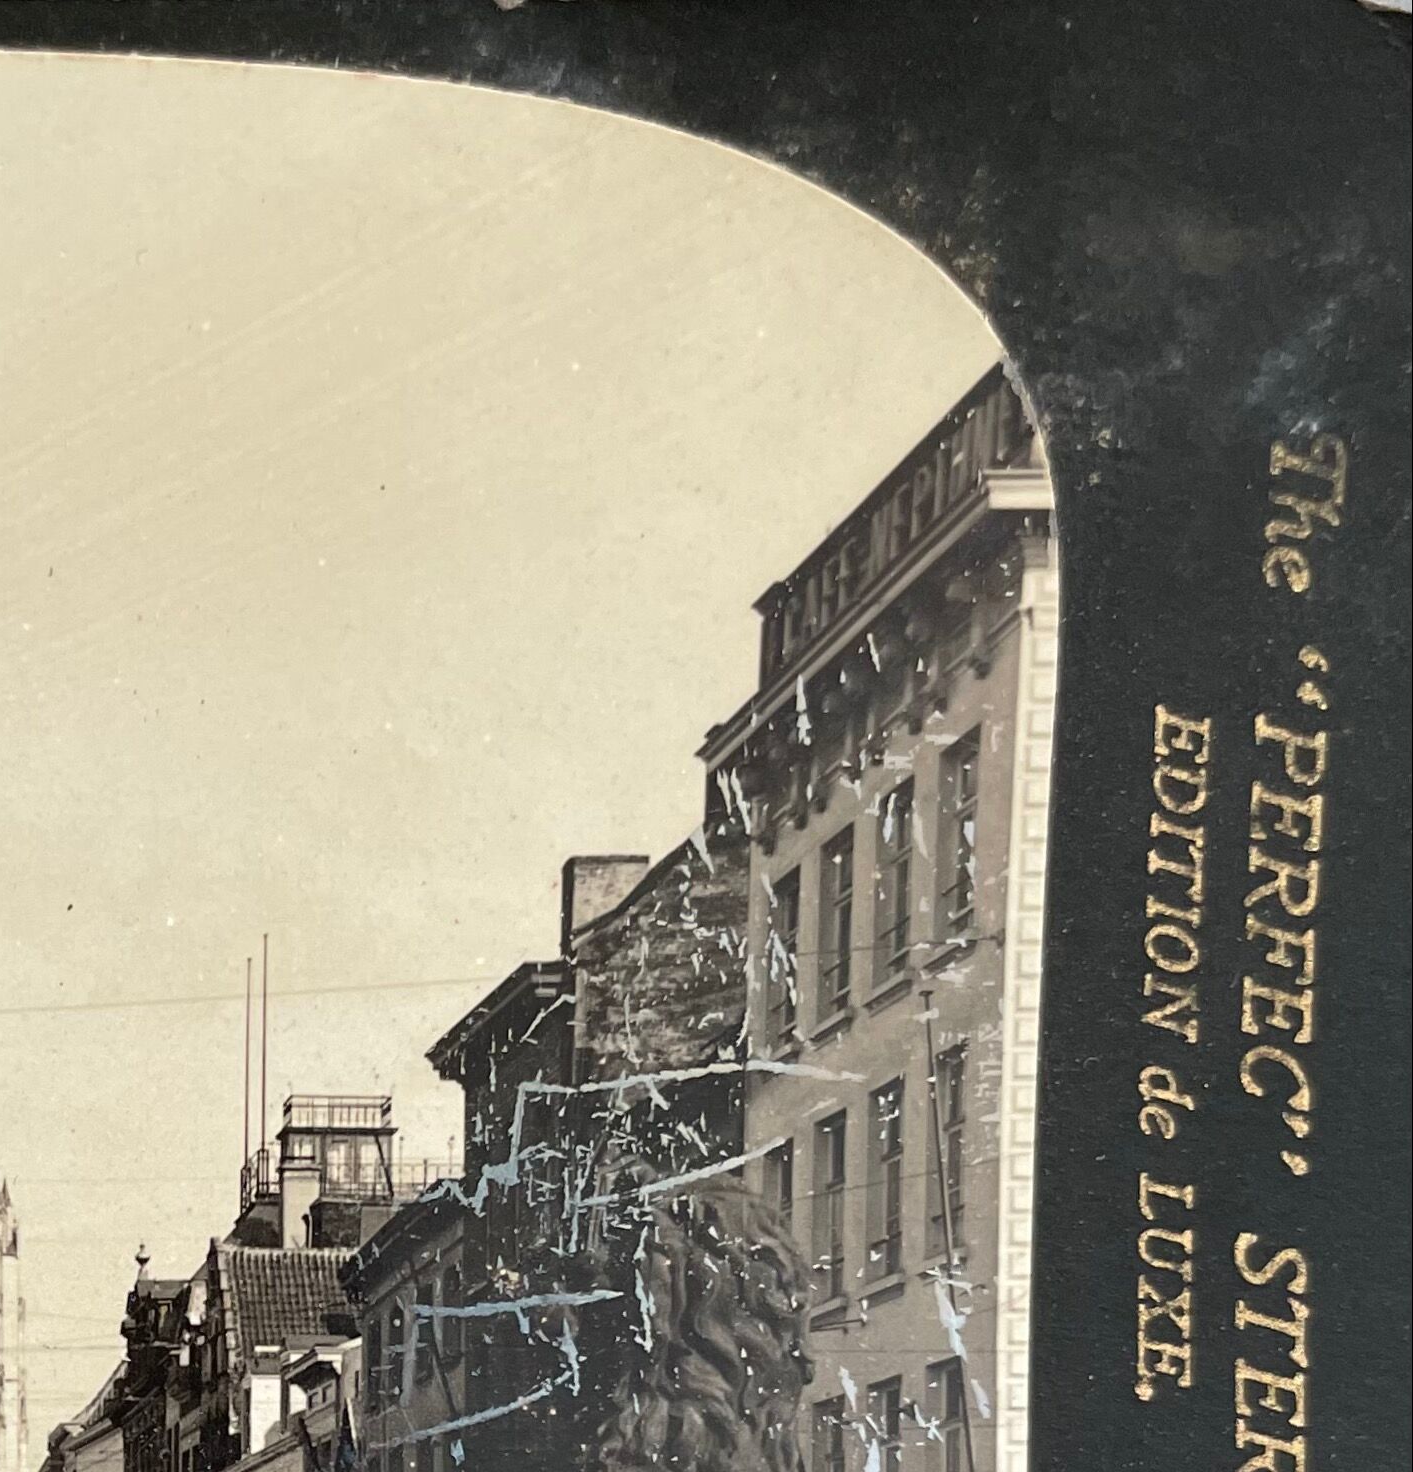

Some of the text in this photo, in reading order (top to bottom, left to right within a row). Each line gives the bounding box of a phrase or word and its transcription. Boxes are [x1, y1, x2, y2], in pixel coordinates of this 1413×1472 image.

[1261, 431, 1347, 594] The
[1140, 703, 1212, 1044] EDITION
[1137, 1064, 1196, 1140] de
[1133, 1171, 1196, 1402] LUXE.
